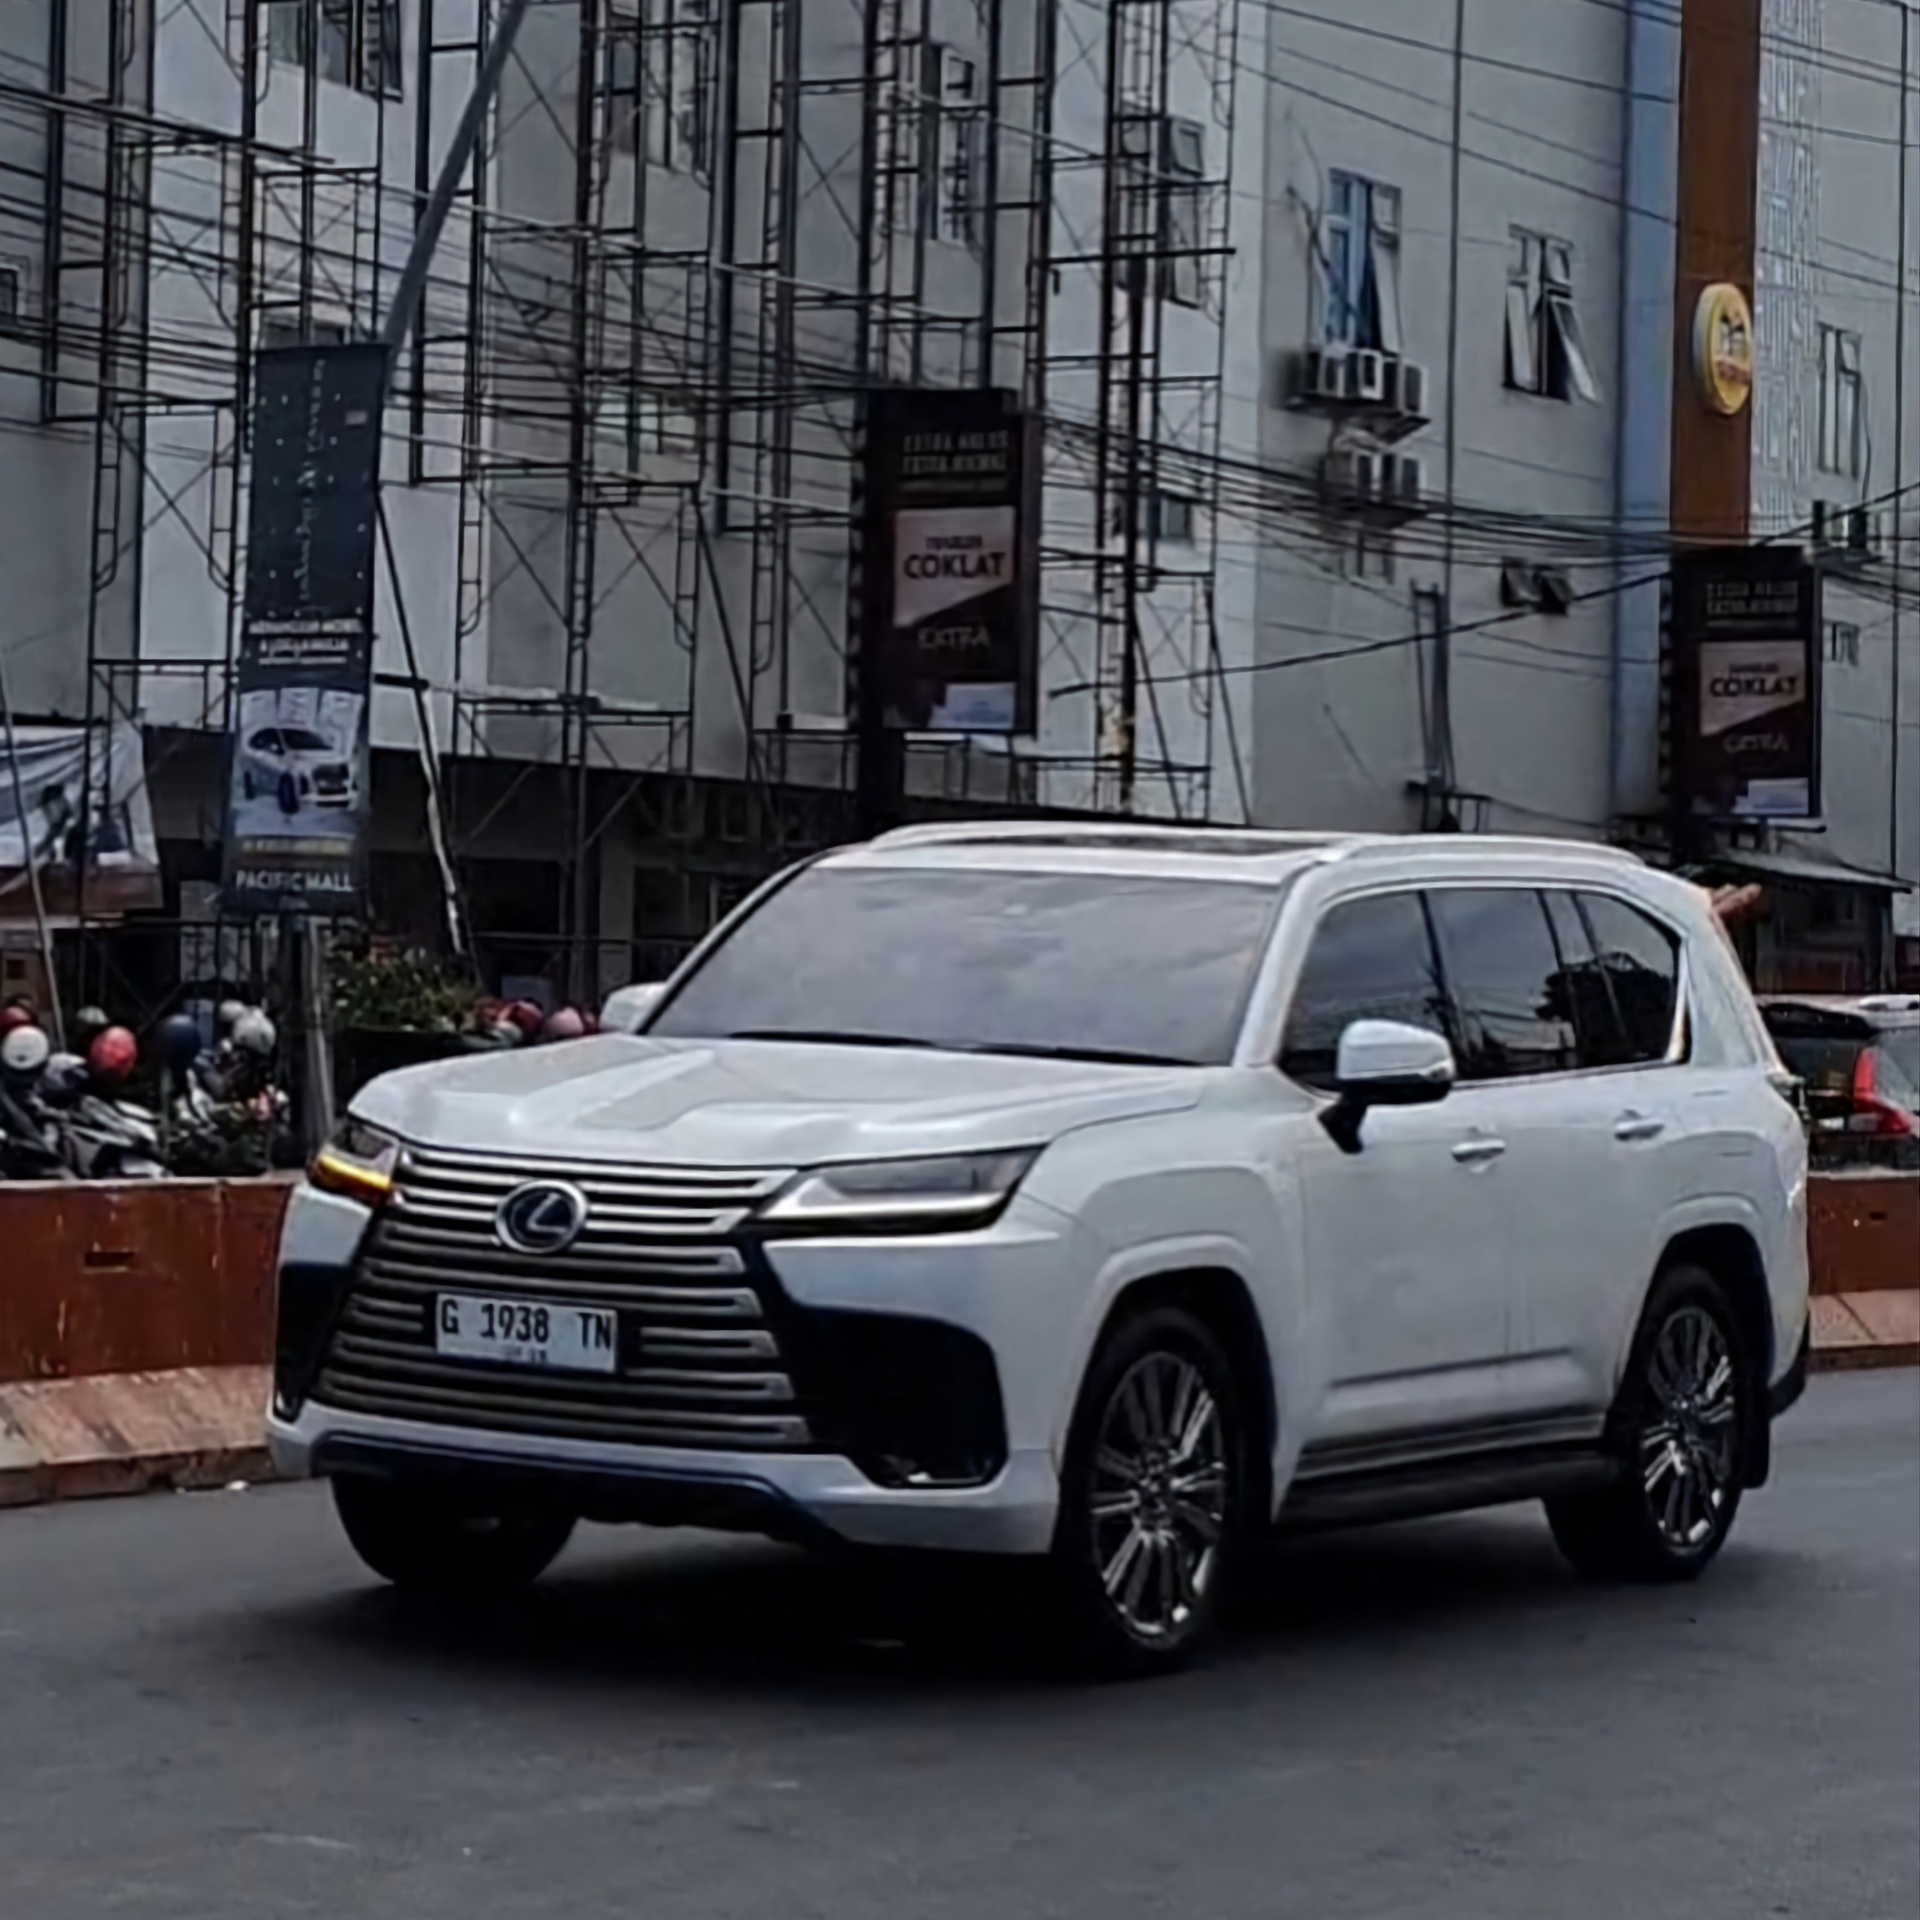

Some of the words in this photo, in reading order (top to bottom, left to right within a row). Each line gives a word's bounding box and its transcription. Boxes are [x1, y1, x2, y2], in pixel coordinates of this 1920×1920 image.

[902, 550, 1007, 579] COKLAT
[1709, 675, 1798, 698] COKLAT
[236, 868, 303, 893] PACIFIC
[305, 870, 353, 893] MALL
[441, 1298, 459, 1334] G
[480, 1303, 550, 1344] 1938
[576, 1311, 612, 1349] TN
